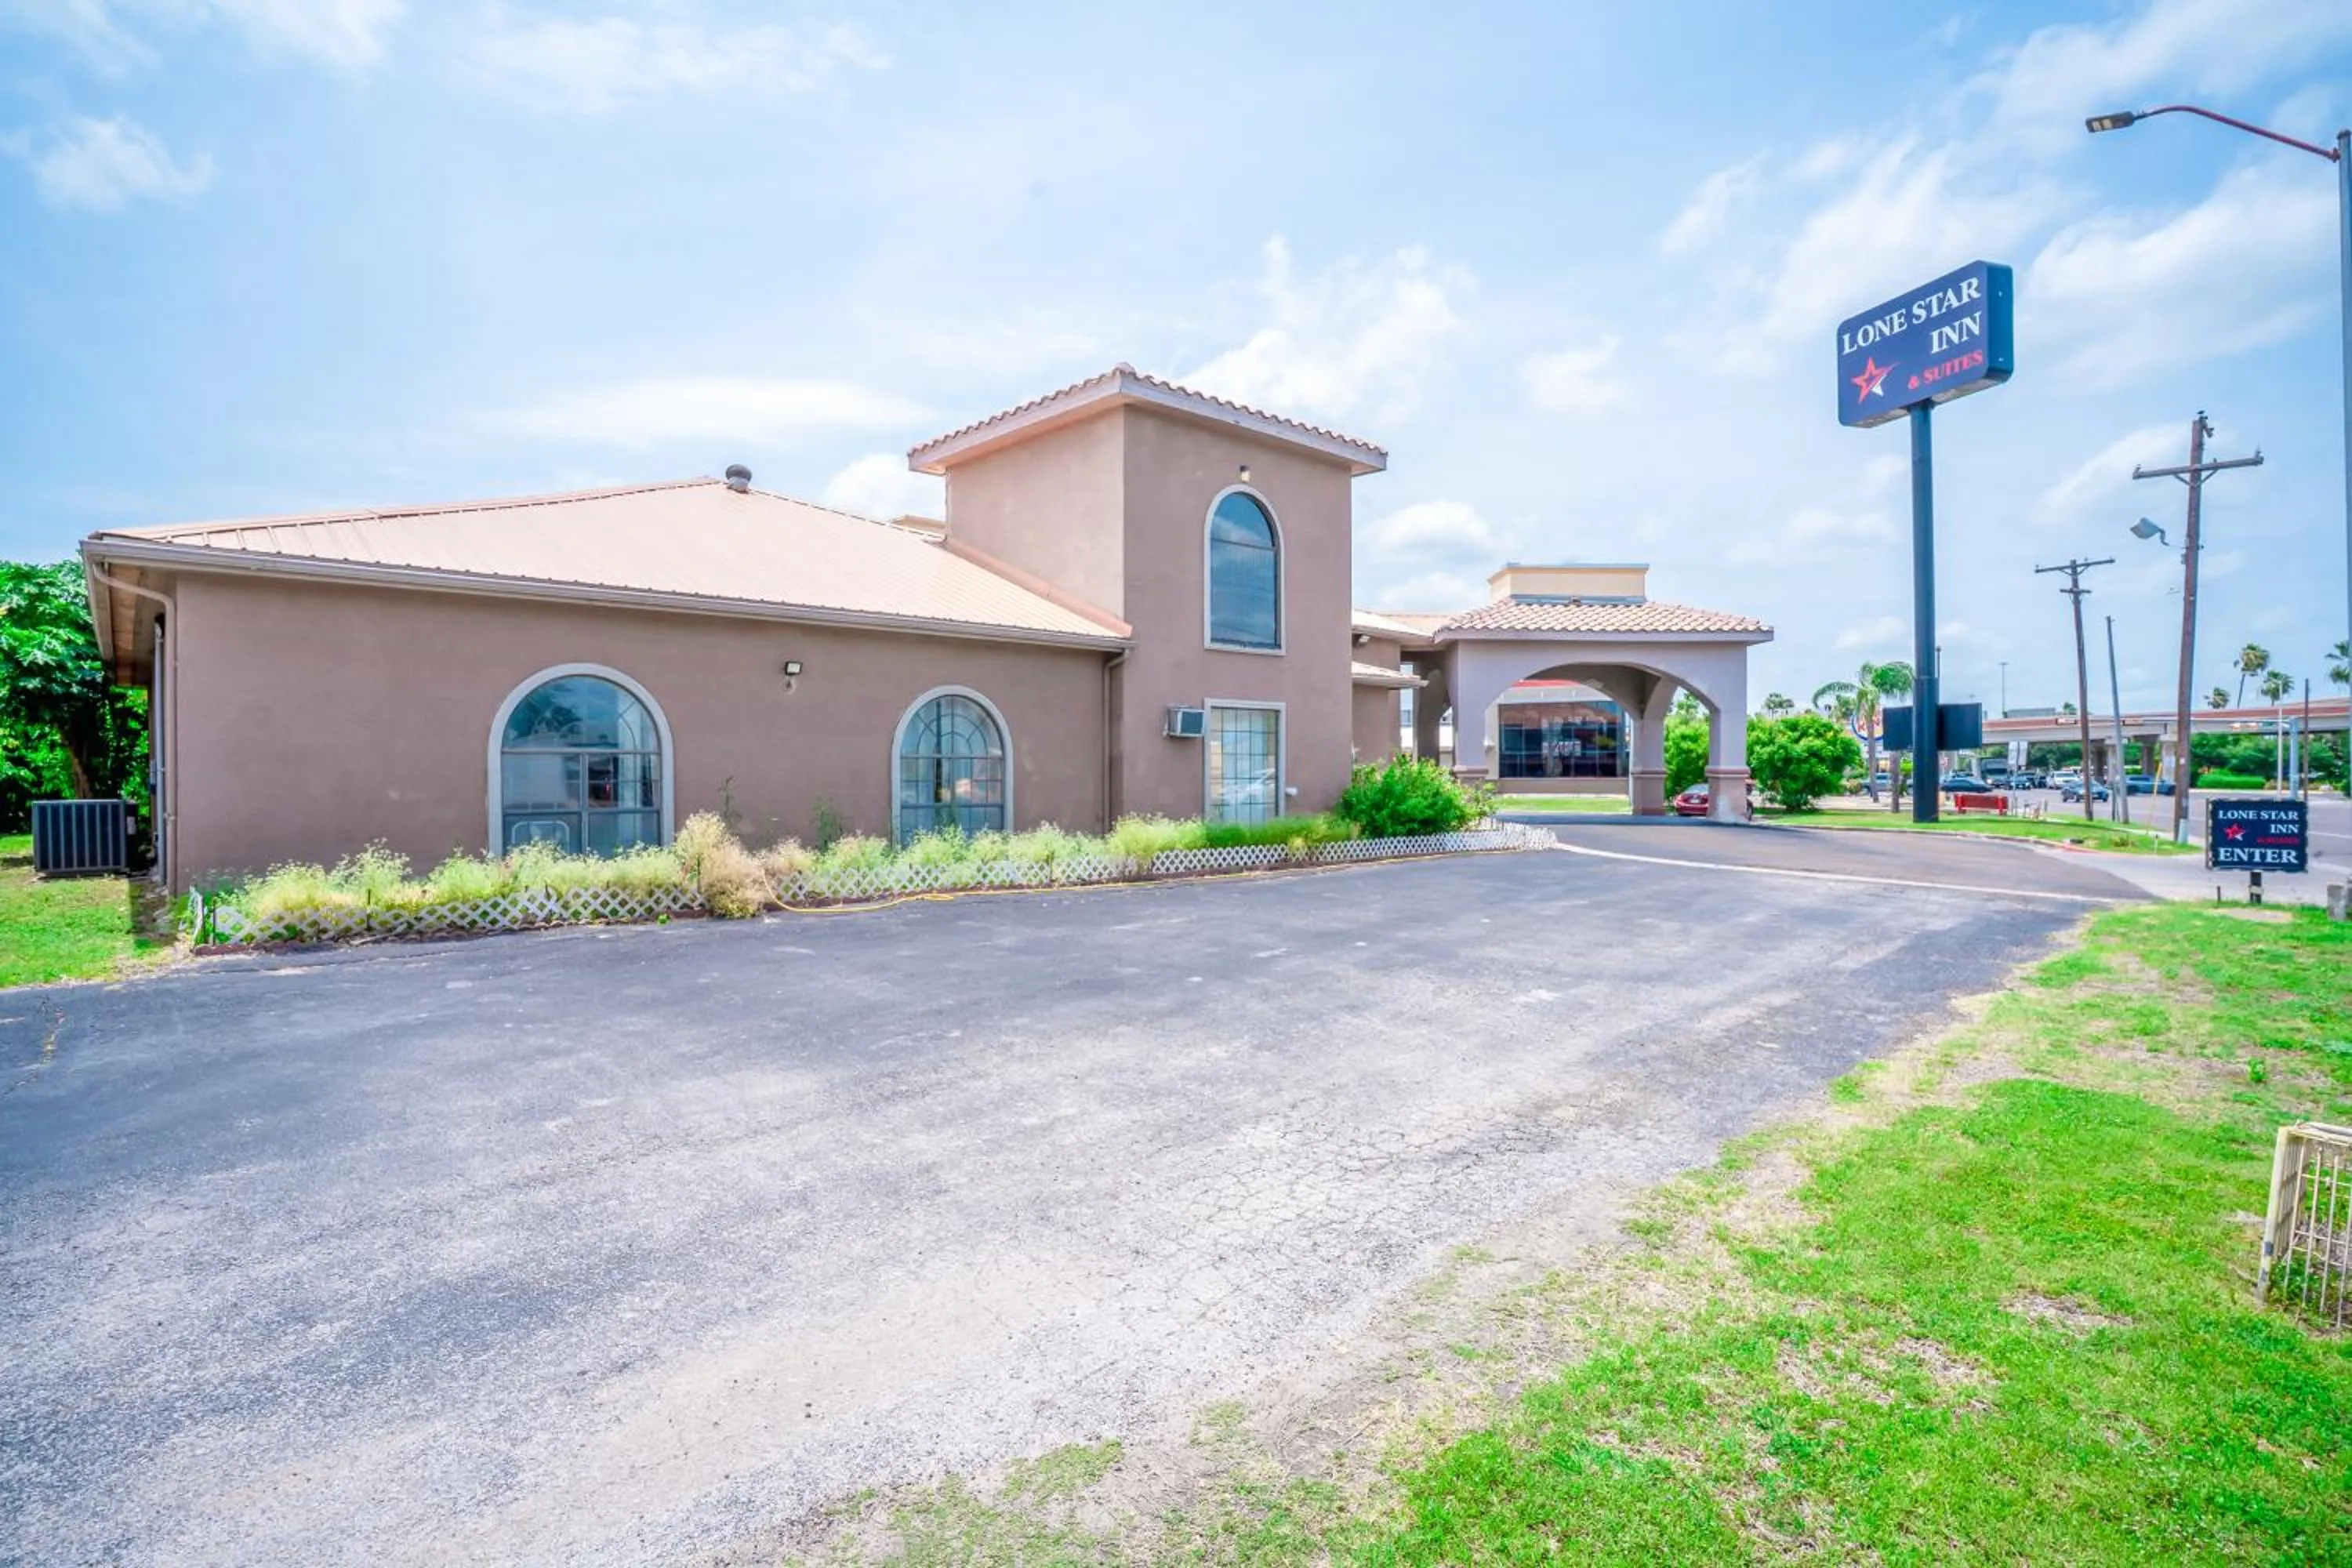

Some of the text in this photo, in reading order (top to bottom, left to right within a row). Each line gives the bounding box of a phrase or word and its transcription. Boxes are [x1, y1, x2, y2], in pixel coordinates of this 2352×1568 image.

[1842, 278, 1981, 354] LONE STAR
[1930, 311, 1982, 354] INN
[1907, 350, 1984, 390] & SUITES
[2218, 810, 2299, 820] LONE STAR
[2270, 824, 2300, 833] INN
[2217, 848, 2299, 864] ENTER
